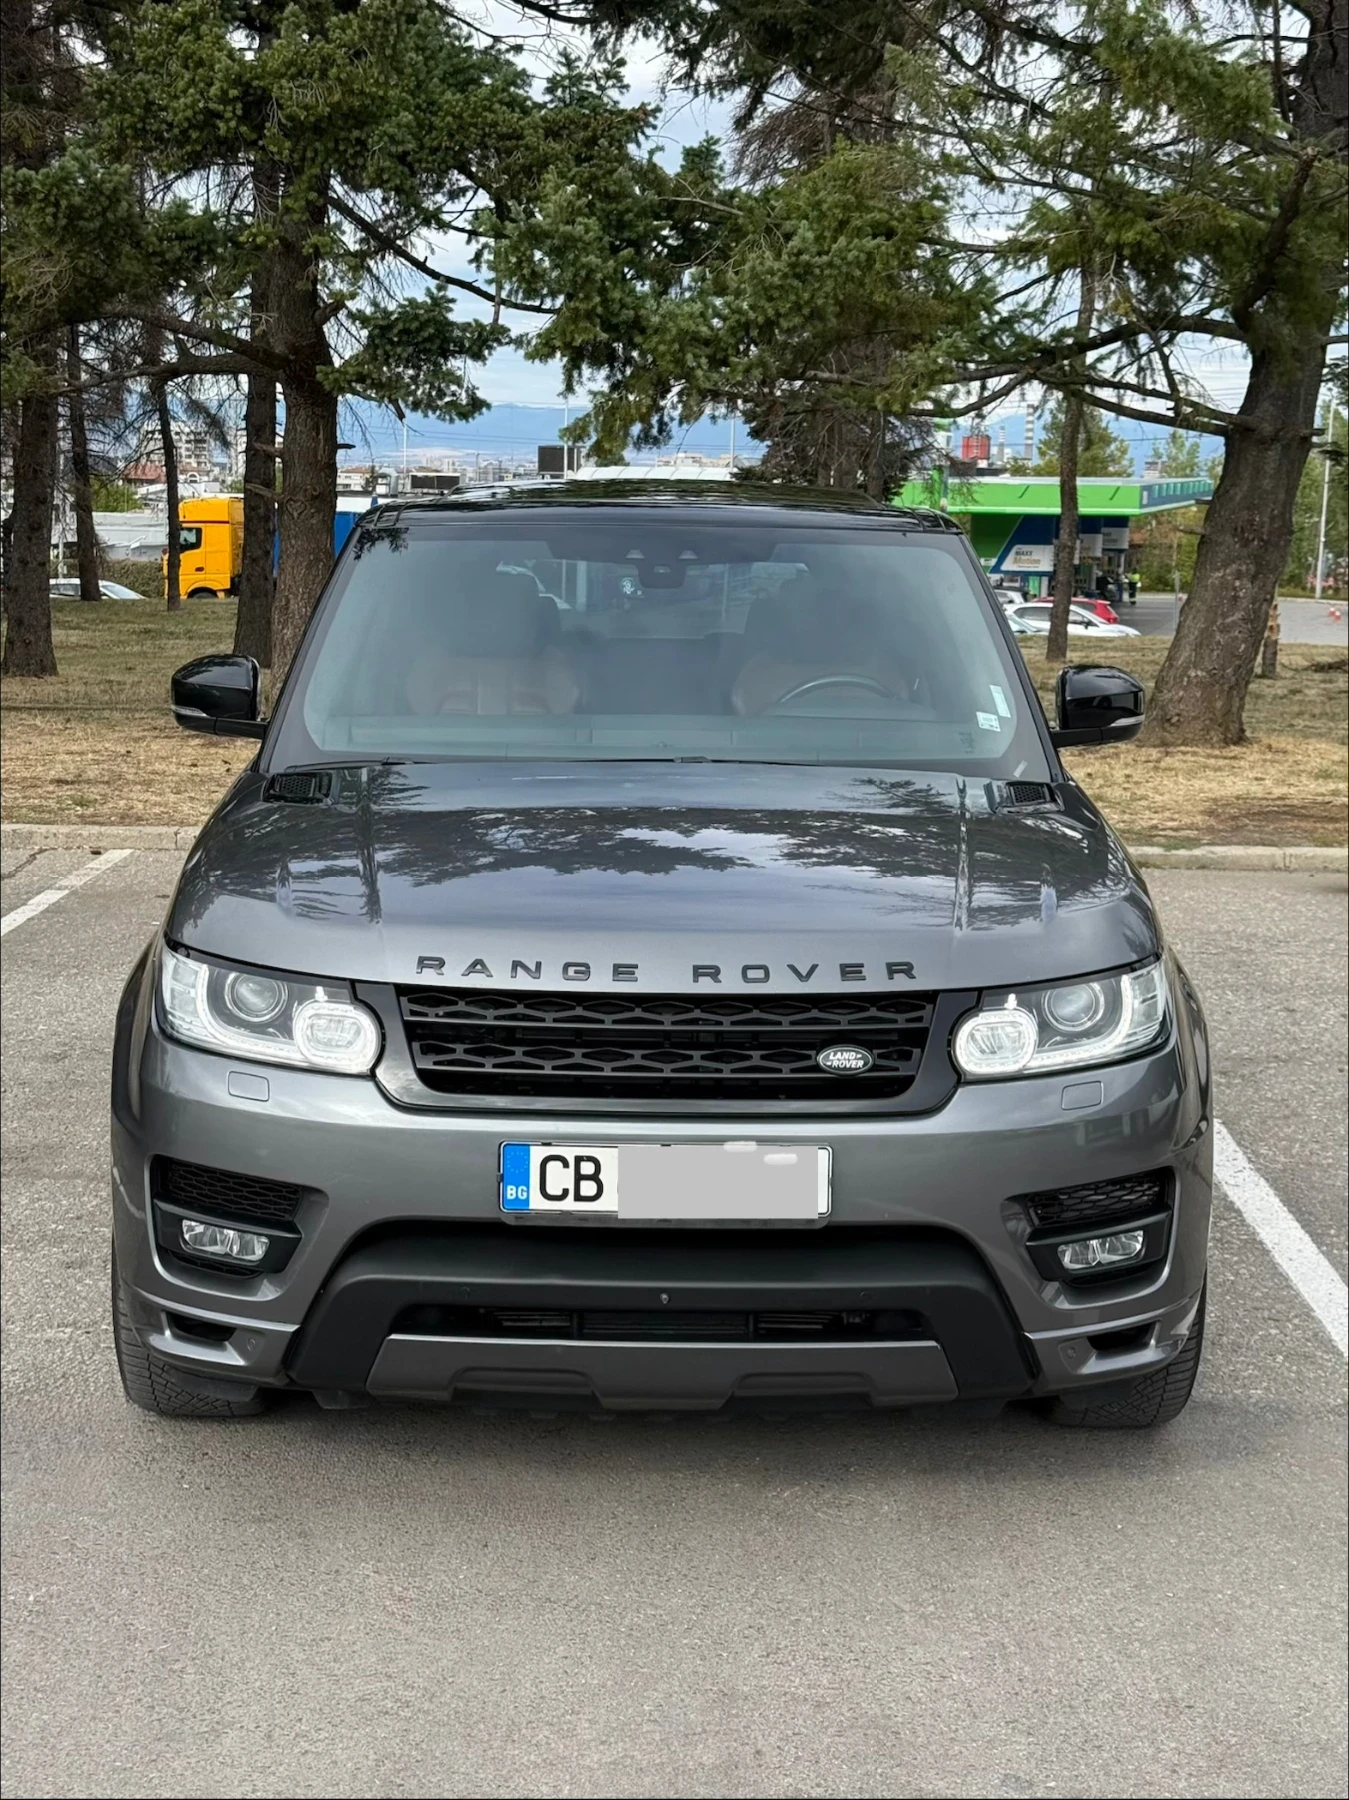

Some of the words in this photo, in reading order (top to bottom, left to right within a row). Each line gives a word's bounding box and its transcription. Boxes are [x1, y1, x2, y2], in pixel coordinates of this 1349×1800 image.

[416, 955, 639, 982] RANGE
[692, 961, 917, 983] ROVER
[829, 1051, 856, 1060] LAND
[831, 1060, 865, 1069] ROVER
[539, 1154, 604, 1202] CB
[506, 1184, 528, 1200] BG
